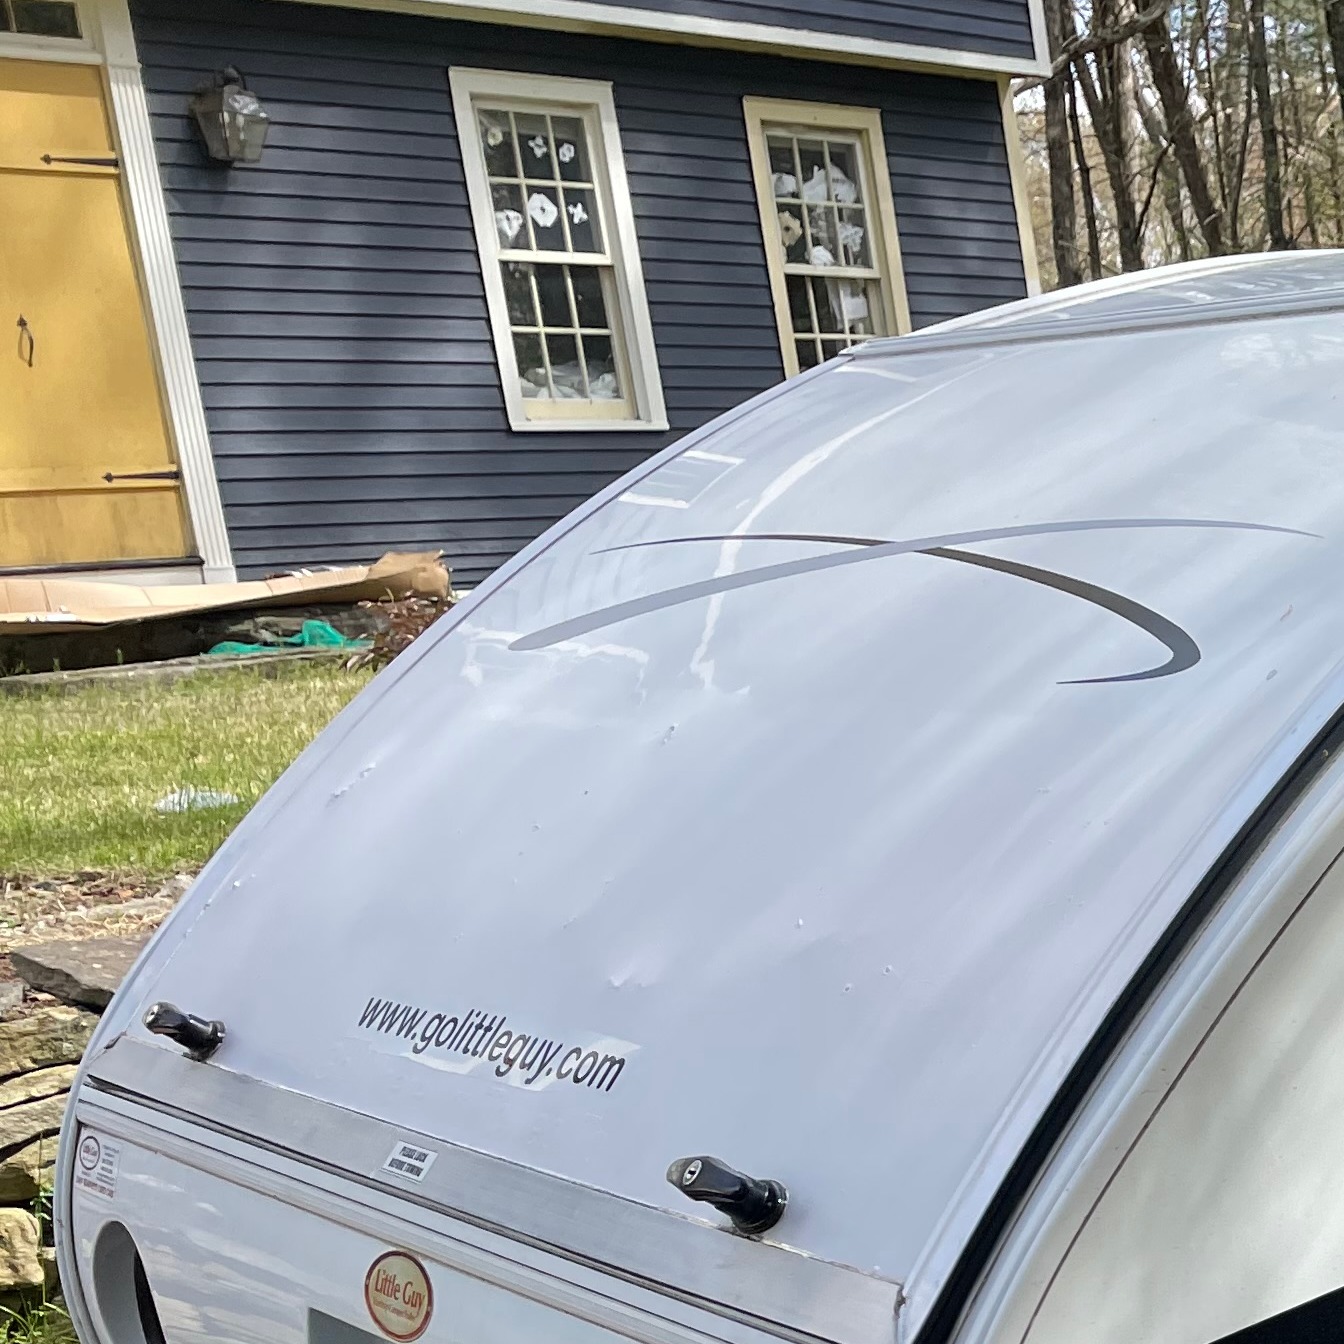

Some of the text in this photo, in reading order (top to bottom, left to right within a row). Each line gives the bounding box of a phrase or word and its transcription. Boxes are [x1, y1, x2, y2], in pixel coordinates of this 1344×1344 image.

[358, 997, 625, 1092] www.golittleguy.com
[375, 1269, 400, 1300] Little
[403, 1281, 425, 1318] Guy
